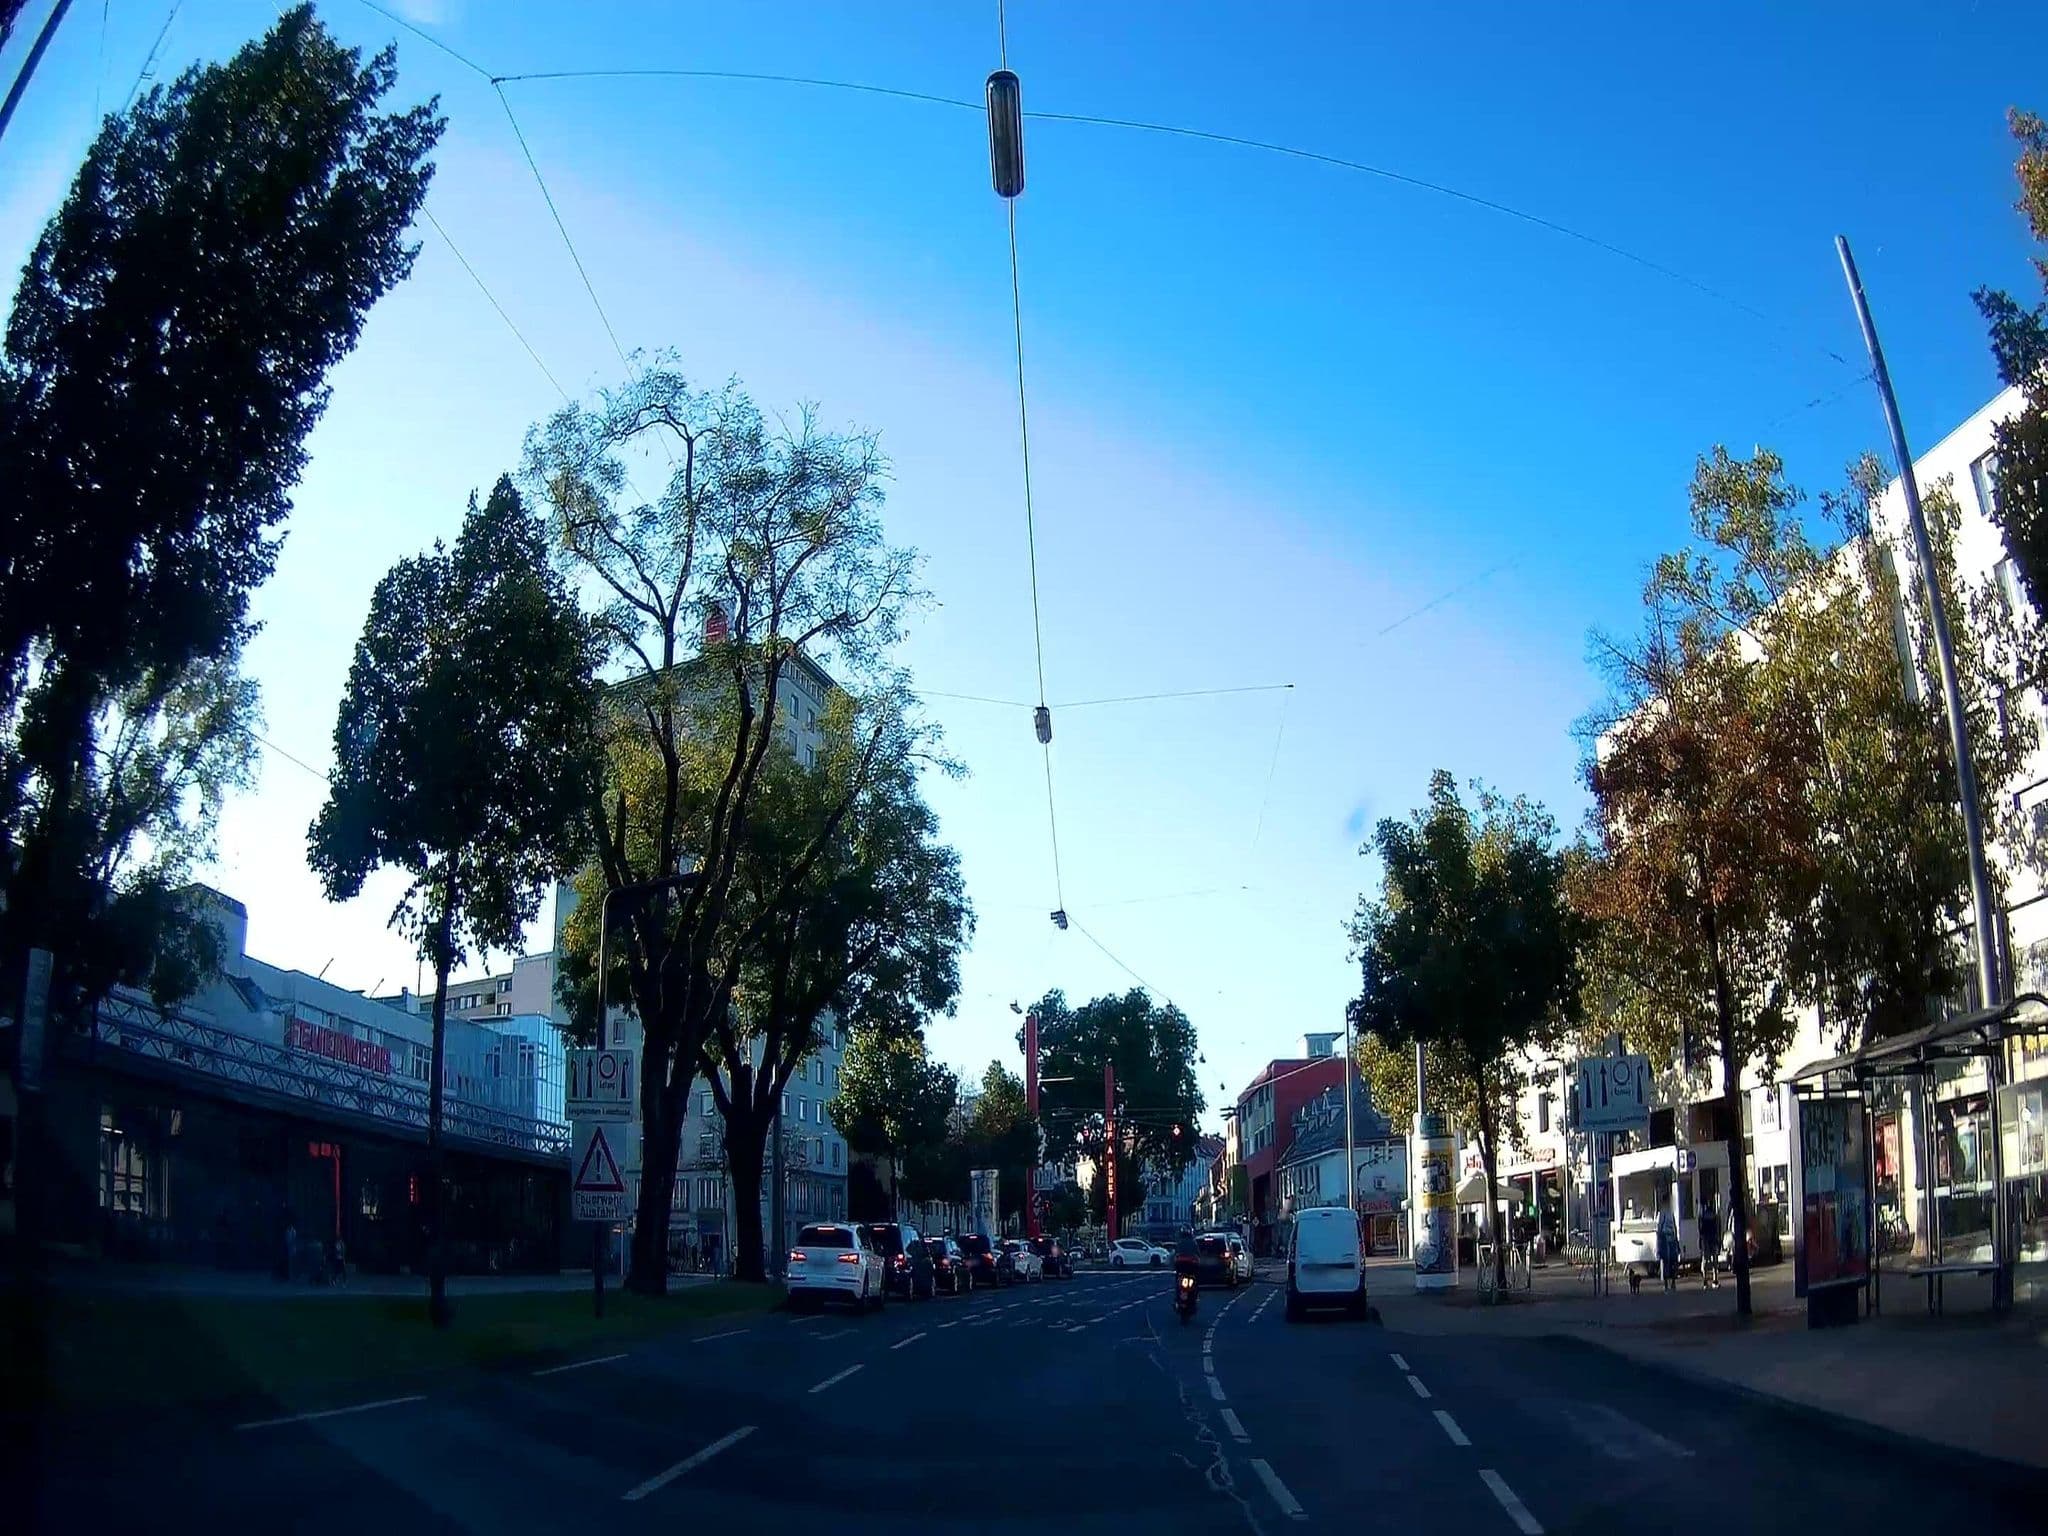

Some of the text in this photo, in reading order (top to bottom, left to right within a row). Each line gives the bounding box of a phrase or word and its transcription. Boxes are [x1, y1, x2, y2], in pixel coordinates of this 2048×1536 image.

[290, 1018, 391, 1075] FEUERWEHR
[575, 1193, 624, 1206] Feuerwehr
[579, 1206, 620, 1219] Ausfahrt
